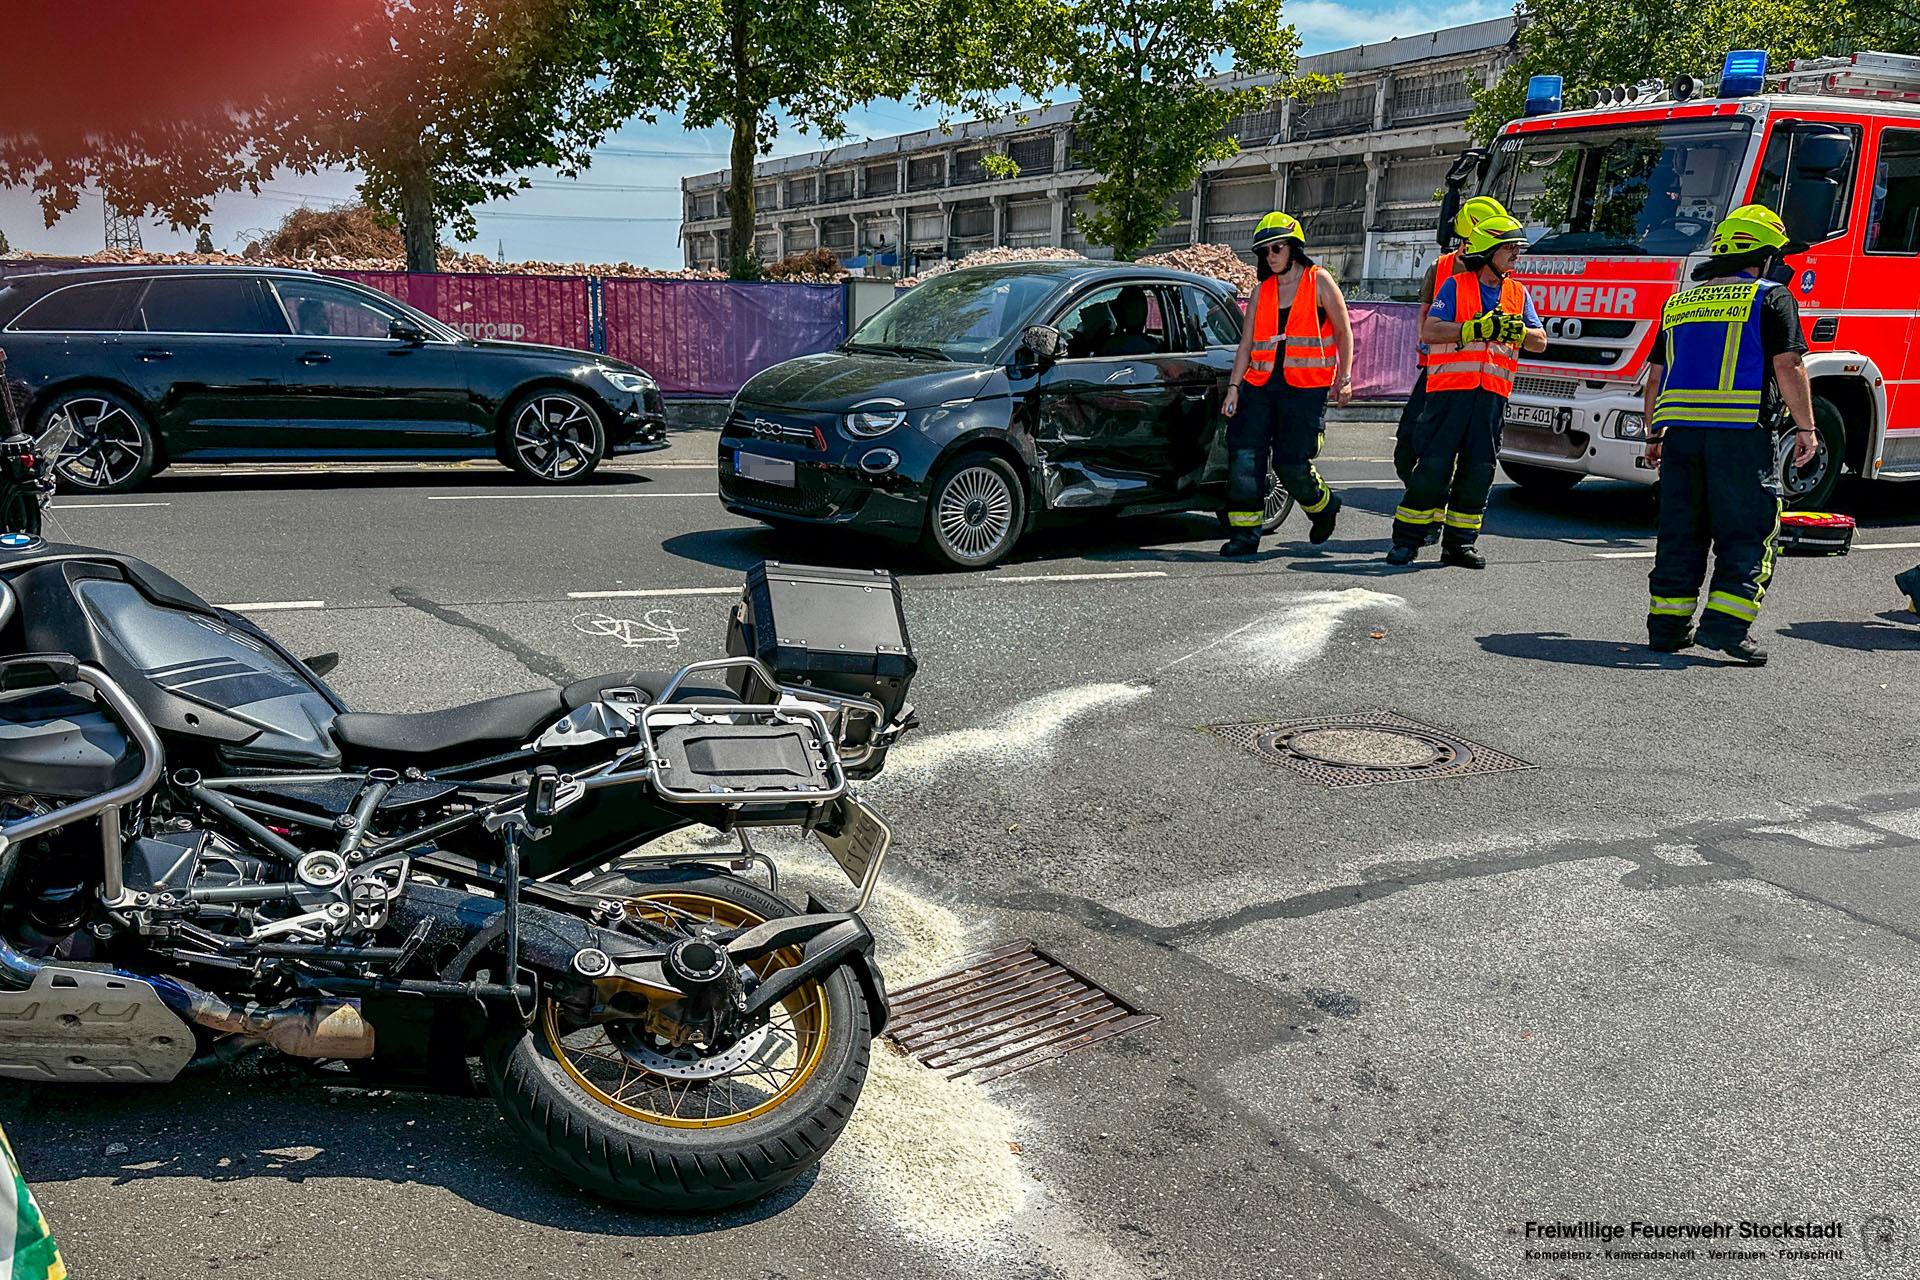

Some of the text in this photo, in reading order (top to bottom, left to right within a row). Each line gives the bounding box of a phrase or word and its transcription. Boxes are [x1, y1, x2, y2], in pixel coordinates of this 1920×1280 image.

[1501, 138, 1525, 152] 40/1
[1514, 260, 1586, 275] MAGIRUS
[1527, 284, 1637, 314] RWEHR
[1667, 292, 1751, 309] STOCKSTADT
[1671, 285, 1753, 302] FEUERWEHR
[1665, 305, 1748, 325] Gruppenführer 40/1
[1517, 407, 1531, 420] FF
[1532, 409, 1551, 423] 401
[754, 418, 783, 435] 500
